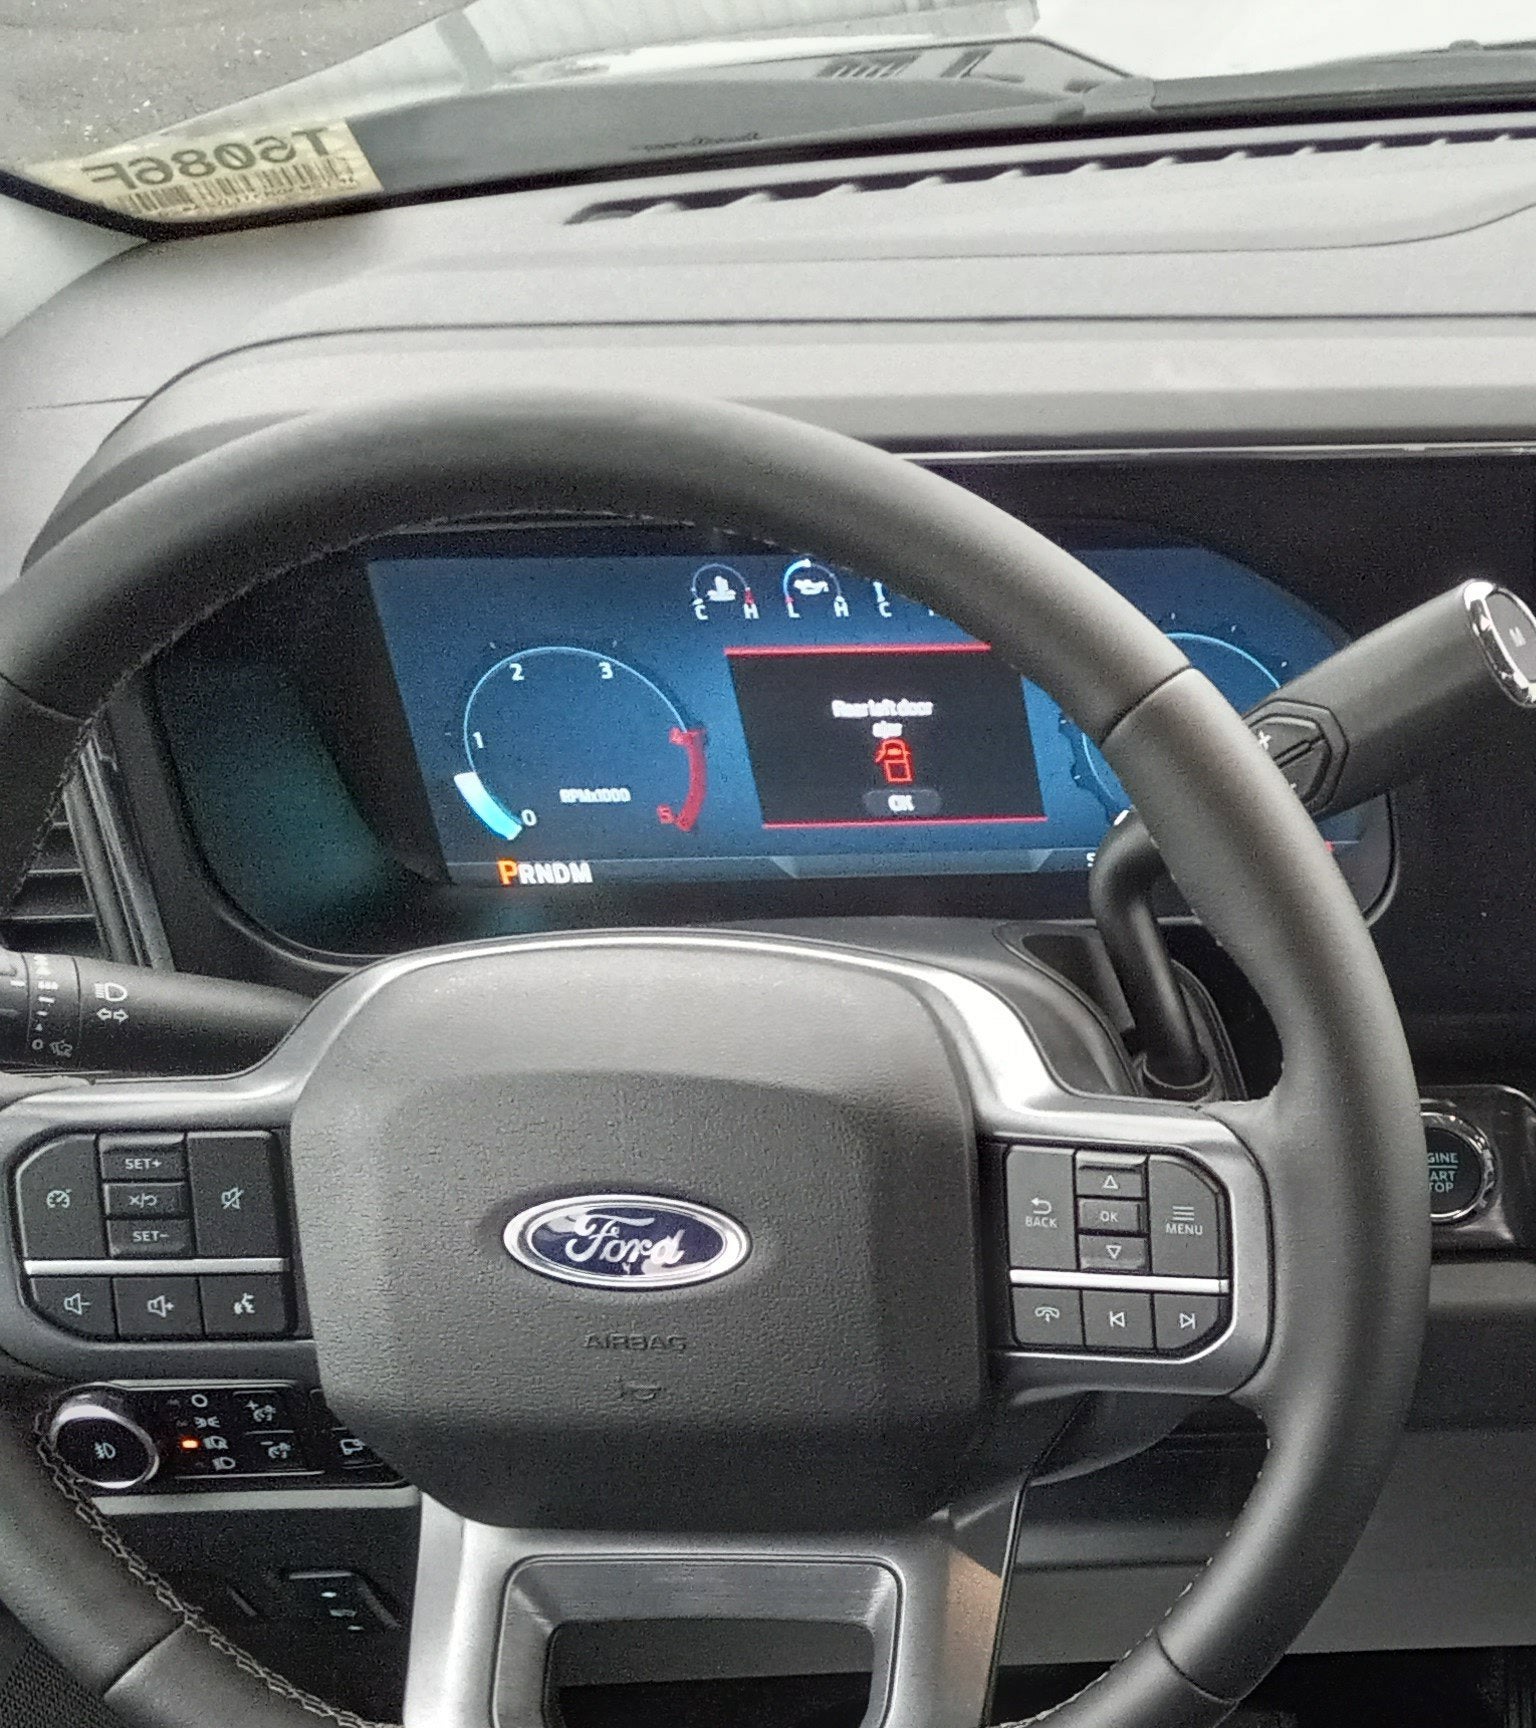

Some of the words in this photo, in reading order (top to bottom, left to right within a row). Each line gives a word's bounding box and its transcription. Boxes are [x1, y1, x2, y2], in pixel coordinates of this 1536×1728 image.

[510, 663, 524, 681] 2
[599, 662, 613, 680] 3
[473, 732, 486, 749] 1
[520, 809, 537, 827] 0
[1427, 1152, 1459, 1164] GINE
[1024, 1216, 1058, 1229] BACK
[1100, 1210, 1118, 1224] OK
[1165, 1222, 1204, 1236] MENU
[565, 1213, 686, 1263] Ford
[583, 1332, 687, 1350] AIRBAG
